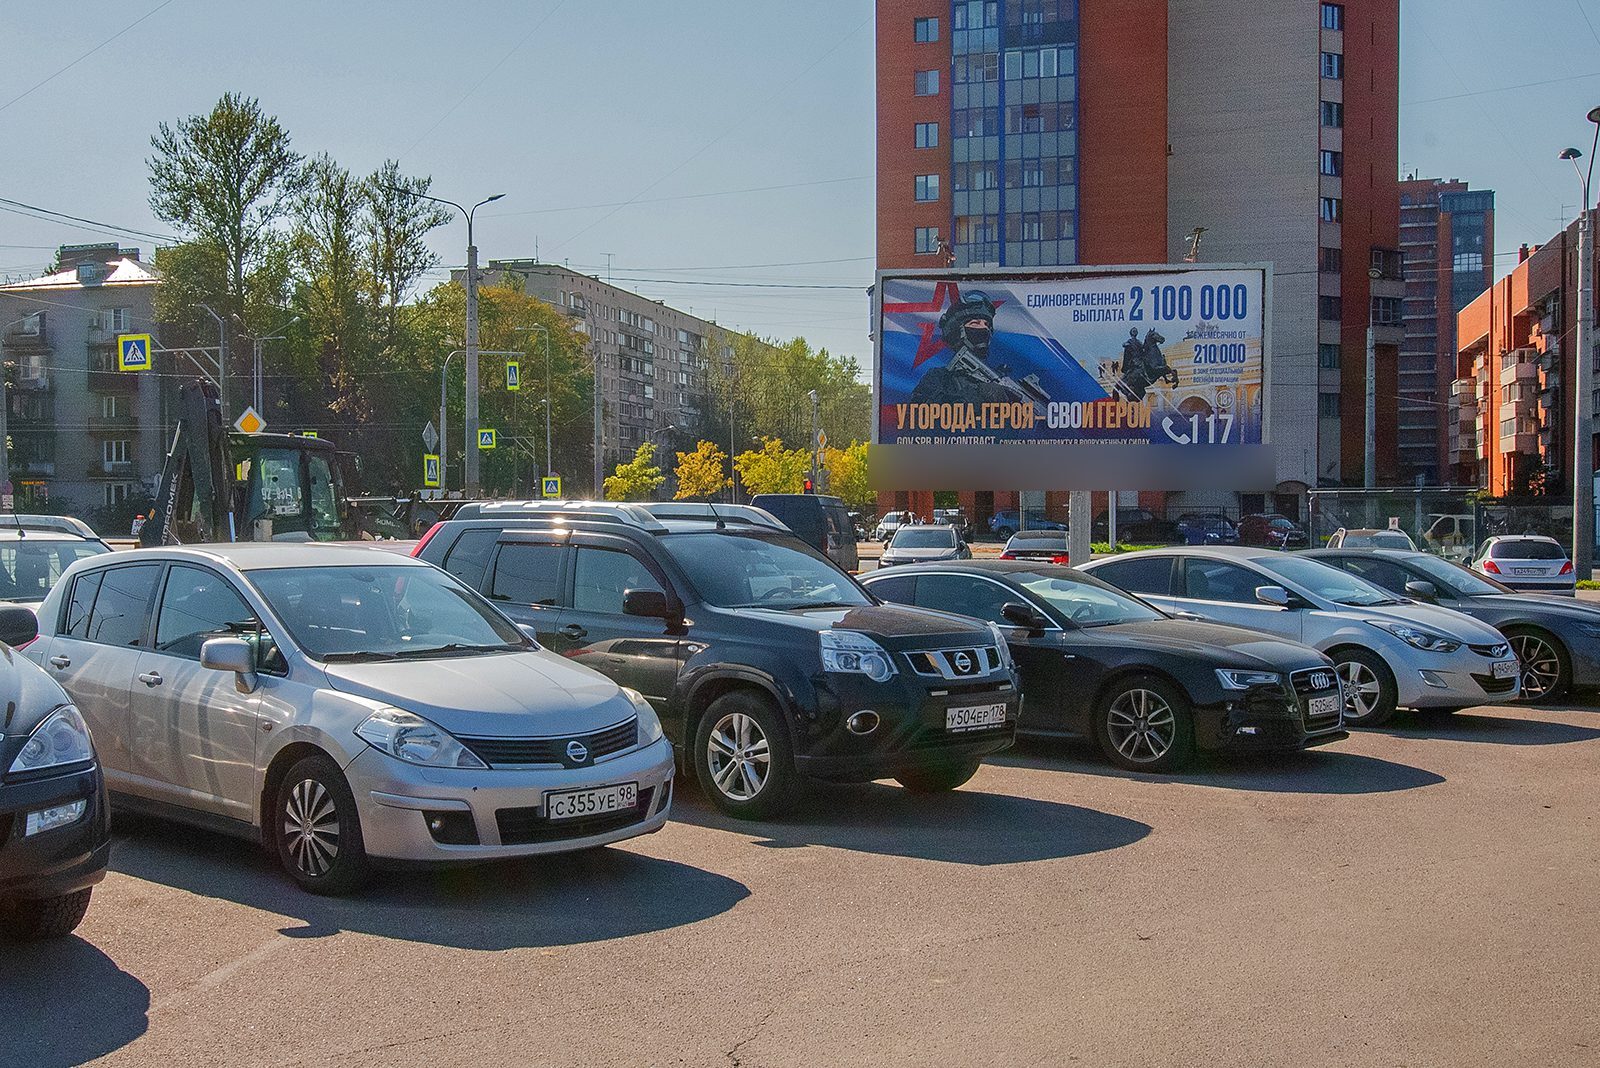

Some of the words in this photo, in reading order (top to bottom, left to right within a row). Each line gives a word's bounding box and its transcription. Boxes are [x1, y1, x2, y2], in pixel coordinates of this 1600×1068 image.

[1027, 293, 1125, 308] ЕДИНОВРЕМЕННАЯ
[1129, 286, 1144, 321] 2
[1150, 285, 1192, 321] 100
[1200, 284, 1248, 321] 000
[1072, 309, 1125, 323] ВЫПЛАТА
[1193, 331, 1237, 340] ЕЖЕМЕСЯЧНО
[1238, 330, 1246, 339] ОТ
[896, 403, 907, 430] У
[909, 402, 1034, 433] ГОРОДА-ГЕРОЯ
[1047, 401, 1094, 429] СВОИ
[1097, 401, 1152, 429] ГЕРОИ
[1189, 414, 1234, 444] 117
